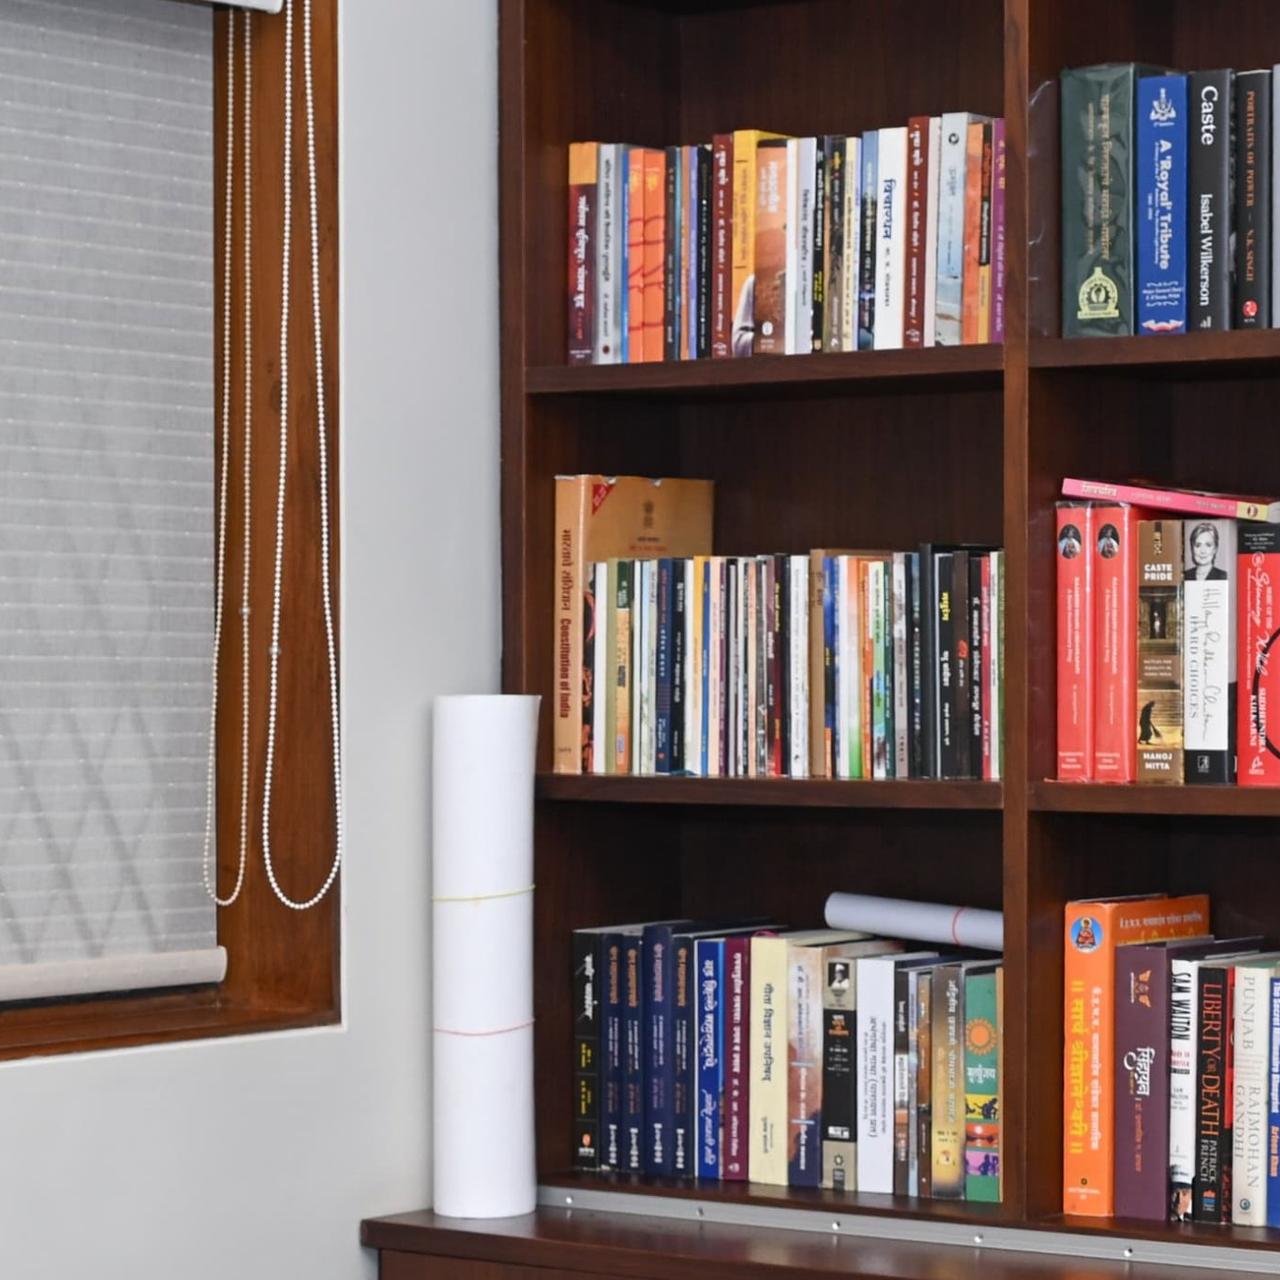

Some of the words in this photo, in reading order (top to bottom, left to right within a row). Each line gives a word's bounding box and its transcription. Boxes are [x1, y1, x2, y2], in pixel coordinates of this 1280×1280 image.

[1200, 85, 1218, 146] Caste
[1246, 91, 1255, 149] PORTRAITS
[1160, 140, 1172, 153] A
[1246, 152, 1255, 165] OF
[1246, 170, 1255, 207] POWER
[883, 179, 896, 239] विचारधन
[1200, 194, 1213, 236] Isabel
[1160, 213, 1172, 270] Tribute
[1199, 237, 1213, 306] Wilkerson
[561, 530, 573, 566] भारताचे
[1144, 564, 1173, 572] CASTE
[561, 570, 574, 610] संविधान
[1144, 573, 1173, 581] PRIDE
[1251, 568, 1269, 626] Spinning
[560, 618, 572, 679] Constitution
[1189, 615, 1199, 655] HARD
[560, 681, 572, 691] of
[560, 692, 572, 718] India
[1189, 659, 1199, 719] CHOICES
[1145, 762, 1170, 770] MITTA
[763, 983, 774, 1004] गीता
[1171, 972, 1192, 993] SAM
[763, 1008, 774, 1038] विज्ञान
[1071, 999, 1089, 1035] सार्थ
[1171, 999, 1191, 1040] WALTON
[1201, 983, 1221, 1059] LIBERTY
[1242, 976, 1256, 1050] PUNJAB
[1272, 998, 1280, 1026] Secret
[761, 1041, 774, 1081] उपनिषद्
[869, 1055, 878, 1075] गाथा
[1271, 1028, 1280, 1073] Millionaire
[1125, 1047, 1155, 1096] सिंहायन
[1200, 1075, 1220, 1136] DEATH
[1270, 1074, 1280, 1113] Blueprint
[1234, 1085, 1245, 1159] GANDHI
[1247, 1087, 1261, 1188] RAJMOHAN
[1200, 1139, 1209, 1182] FRENCH
[1209, 1140, 1217, 1183] PATRICK
